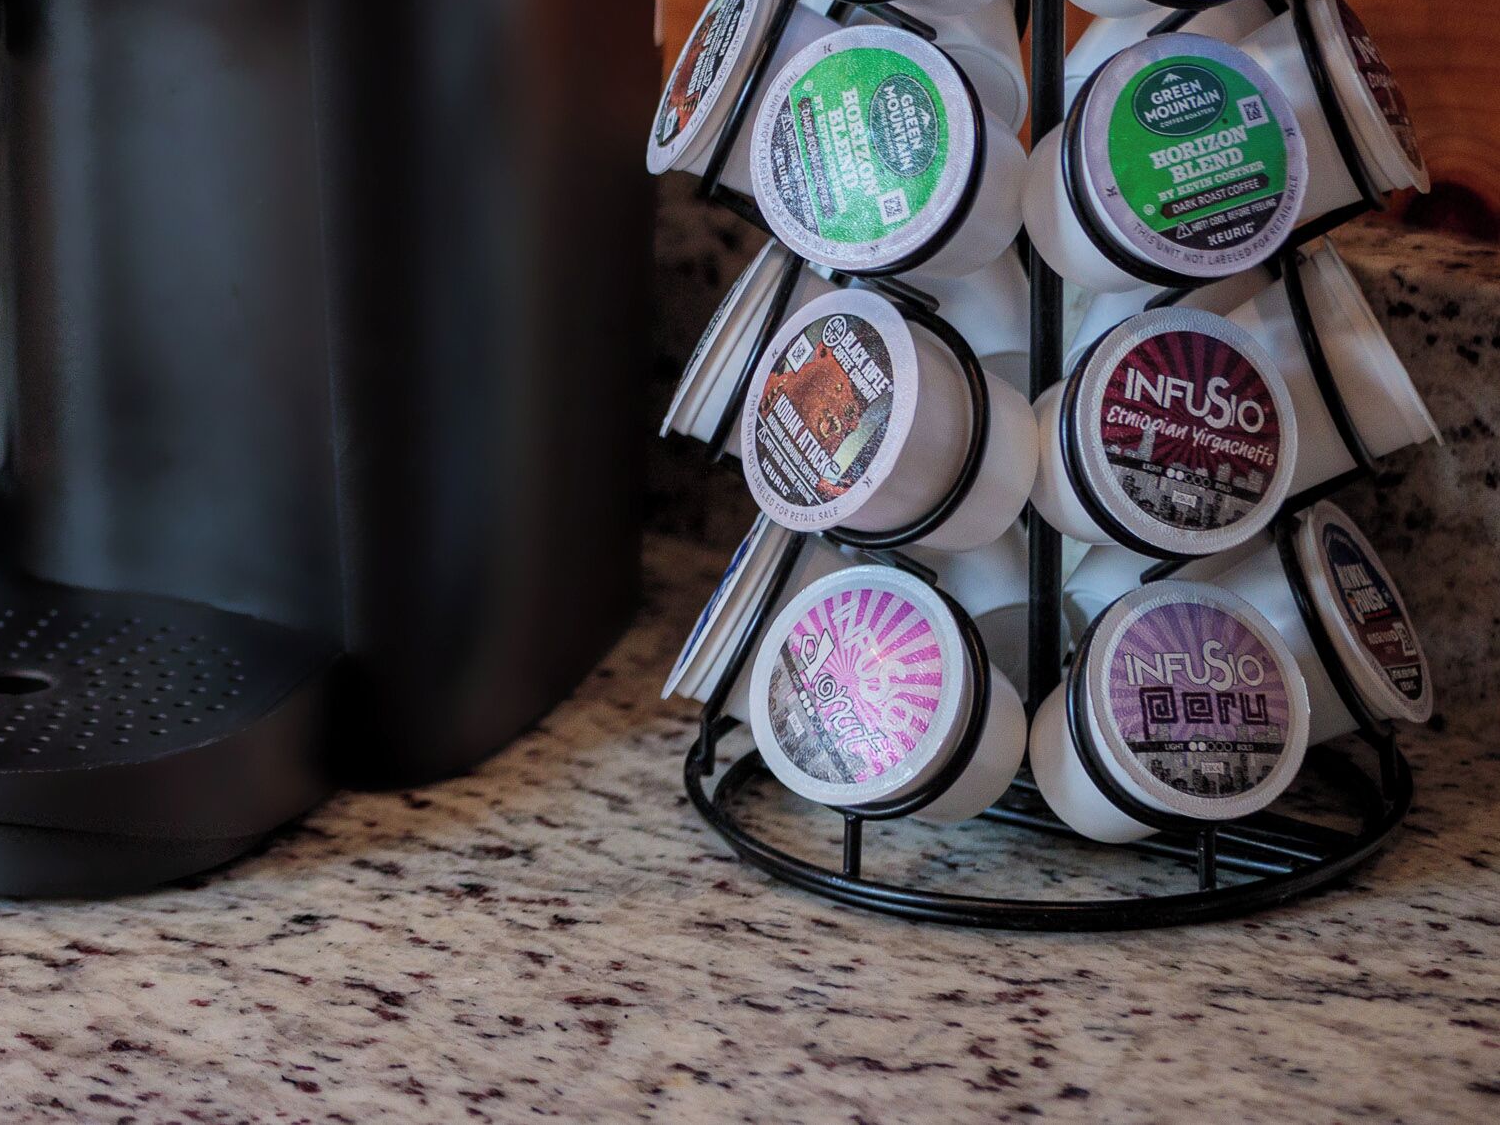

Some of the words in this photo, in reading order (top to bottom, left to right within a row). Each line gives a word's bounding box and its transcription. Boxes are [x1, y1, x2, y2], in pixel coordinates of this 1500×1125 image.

[703, 84, 717, 107] UNIT
[717, 62, 729, 83] NOT
[768, 93, 782, 118] UNIT
[1144, 90, 1221, 123] MOUNTAIN
[1151, 79, 1203, 105] GREEN
[828, 107, 859, 188] BLEND
[842, 88, 880, 195] HORIZON
[883, 84, 915, 170] MOUNTAIN
[900, 94, 923, 151] GREEN
[1149, 125, 1248, 170] HORIZON
[773, 146, 793, 199] KEURIG
[1158, 191, 1174, 202] BY
[1177, 178, 1214, 196] KEVIN
[1169, 148, 1244, 185] BLEND
[1133, 222, 1154, 245] THIS
[1157, 240, 1181, 259] UNIT
[1184, 250, 1204, 265] NOT
[1208, 248, 1251, 266] LABELED
[1253, 236, 1269, 255] FOR
[1269, 203, 1293, 239] RETAIL
[1289, 175, 1299, 201] SALE
[1171, 196, 1198, 214] DARK
[1199, 187, 1227, 208] ROAST
[1228, 178, 1260, 197] COFFEE
[1207, 224, 1254, 246] KEURIG
[833, 345, 850, 373] COFFEE
[848, 366, 879, 404] COMPANY
[841, 331, 865, 372] BLACK
[860, 362, 888, 396] RIFLE
[1125, 367, 1265, 433] INFUSIO
[766, 414, 784, 439] MEDIUM
[781, 436, 802, 468] GROUND
[799, 462, 820, 488] COFFEE
[773, 393, 804, 440] KODIAK
[796, 430, 832, 478] ATTACK
[1106, 405, 1189, 440] Ethiopian
[1192, 425, 1275, 467] Yirgacheffe
[761, 458, 790, 497] KEURIG
[1142, 463, 1163, 474] LIGHT
[751, 473, 776, 507] LABELED
[775, 503, 789, 516] FOR
[789, 511, 816, 523] RETAIL
[818, 505, 838, 520] SALE
[1124, 639, 1264, 692] INFUSIO
[800, 628, 888, 757] donut
[1164, 742, 1184, 751] LIGHT
[1236, 743, 1254, 752] BOLD
